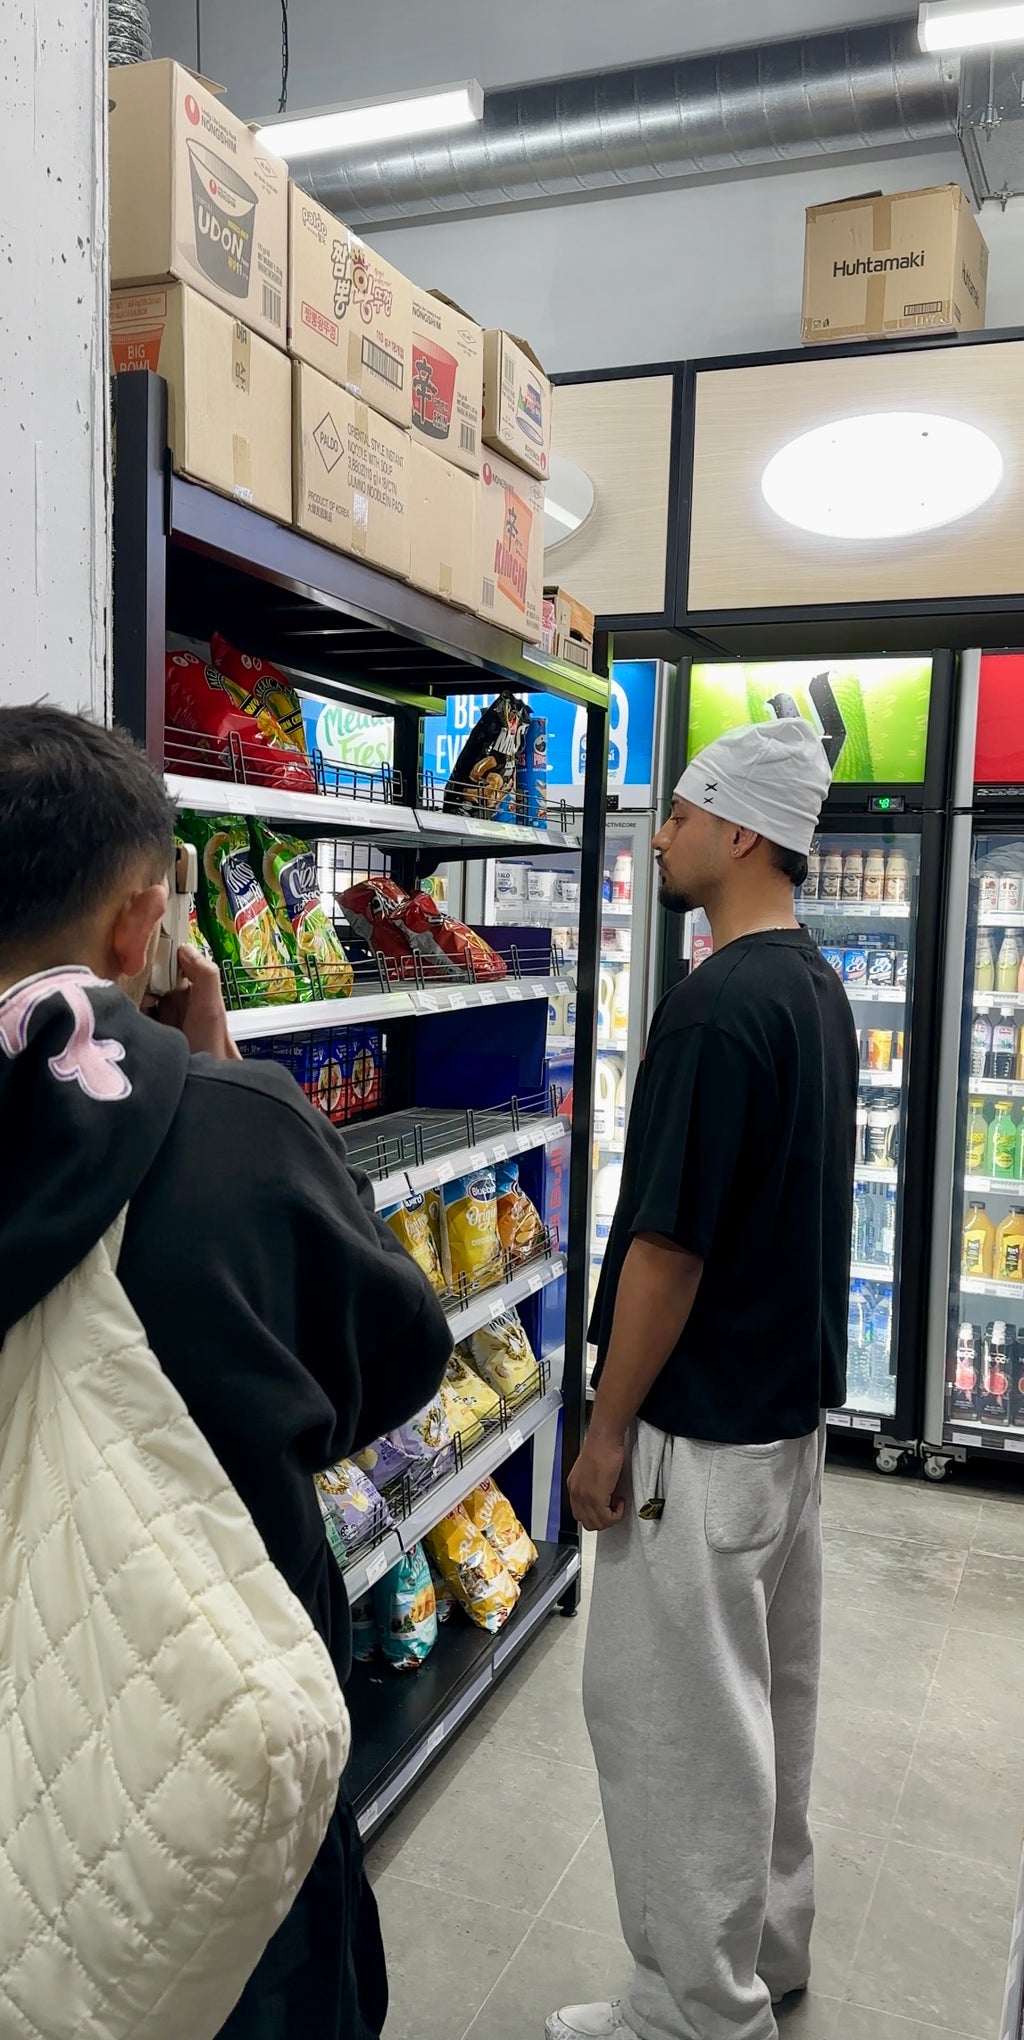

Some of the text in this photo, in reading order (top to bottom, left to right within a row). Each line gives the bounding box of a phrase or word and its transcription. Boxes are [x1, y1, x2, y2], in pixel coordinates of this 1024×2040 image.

[201, 114, 237, 154] NONGSHIM
[198, 205, 243, 260] UDON
[833, 251, 924, 277] Huhtamaki
[412, 306, 441, 330] NONGSHIM
[128, 344, 145, 360] BIG
[319, 432, 338, 453] PALDO
[371, 438, 385, 457] STYLE
[308, 490, 328, 508] PRODUCT
[336, 505, 349, 519] KOREA
[494, 539, 528, 603] KIMCHI
